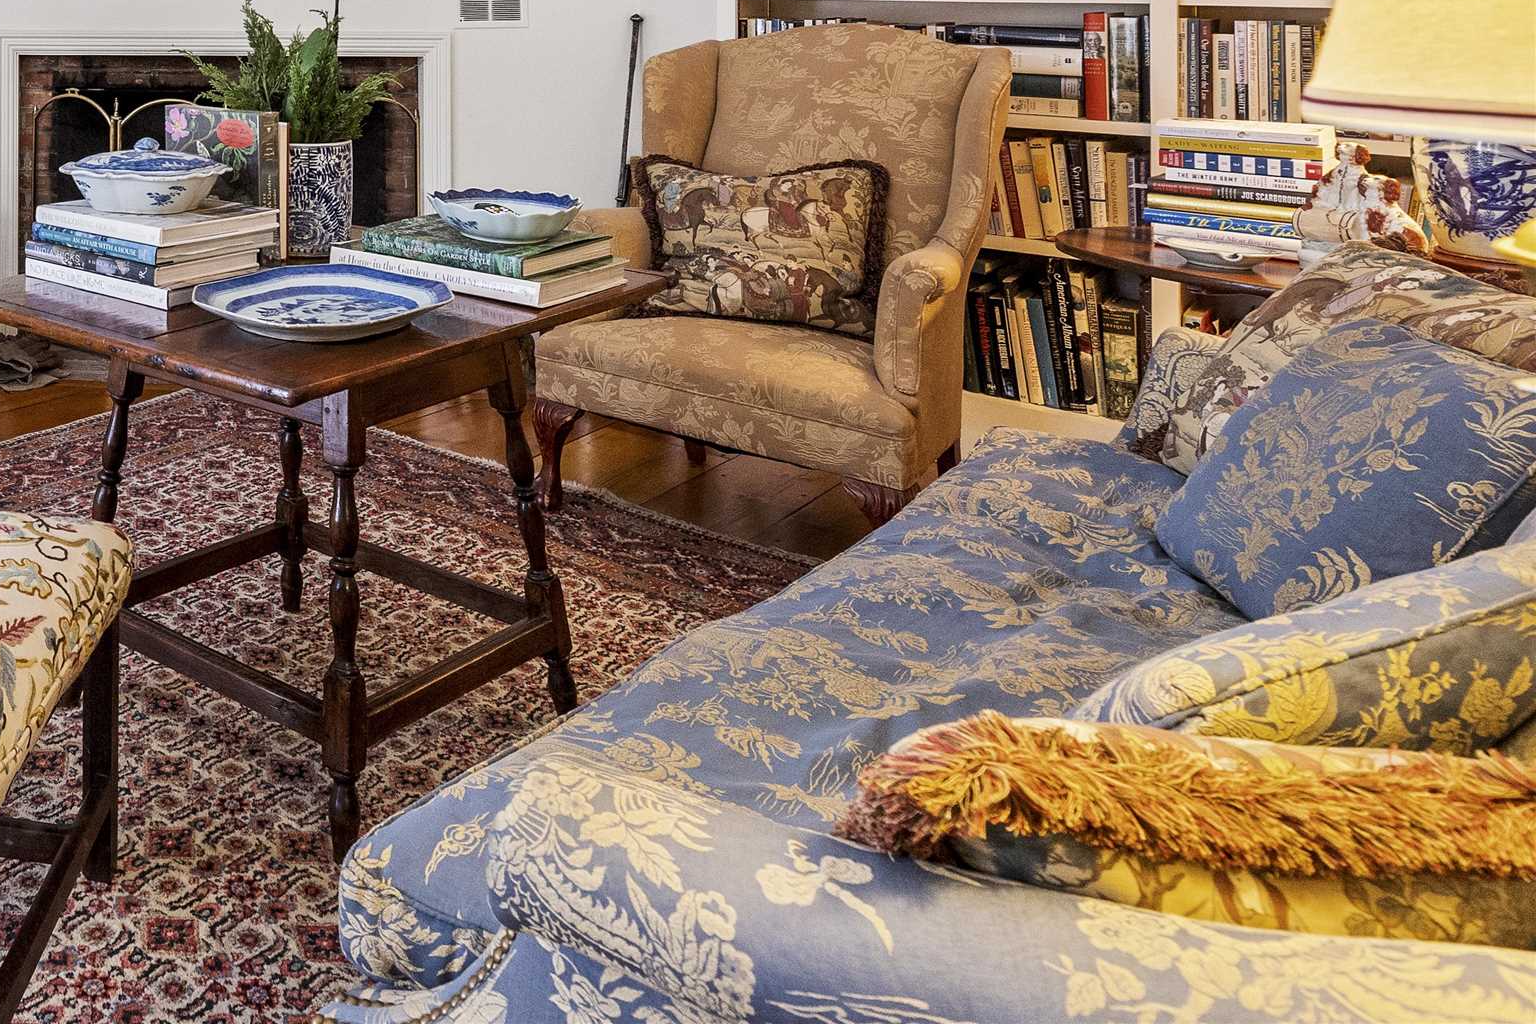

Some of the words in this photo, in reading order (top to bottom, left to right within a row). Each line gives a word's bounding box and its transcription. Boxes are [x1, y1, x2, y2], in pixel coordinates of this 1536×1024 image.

[1201, 39, 1209, 50] Our
[1201, 65, 1209, 81] Before
[1071, 166, 1082, 187] SOUL
[1074, 190, 1085, 218] MATES
[1241, 191, 1254, 200] JOE
[1255, 192, 1306, 204] SCARBOROUGH
[1187, 216, 1209, 226] I'll
[1214, 218, 1253, 233] Drink
[81, 239, 97, 248] AFFAIR
[98, 242, 113, 250] WITH
[118, 246, 136, 256] HOUSE
[348, 254, 370, 267] Home
[372, 258, 381, 269] in
[383, 259, 395, 271] the
[397, 262, 429, 278] Garden
[440, 250, 468, 261] GARDEN
[469, 254, 491, 265] STYLE
[1054, 273, 1068, 317] American
[996, 329, 1006, 344] BLACK
[1060, 317, 1074, 349] Album
[998, 344, 1010, 369] LIBERATION
